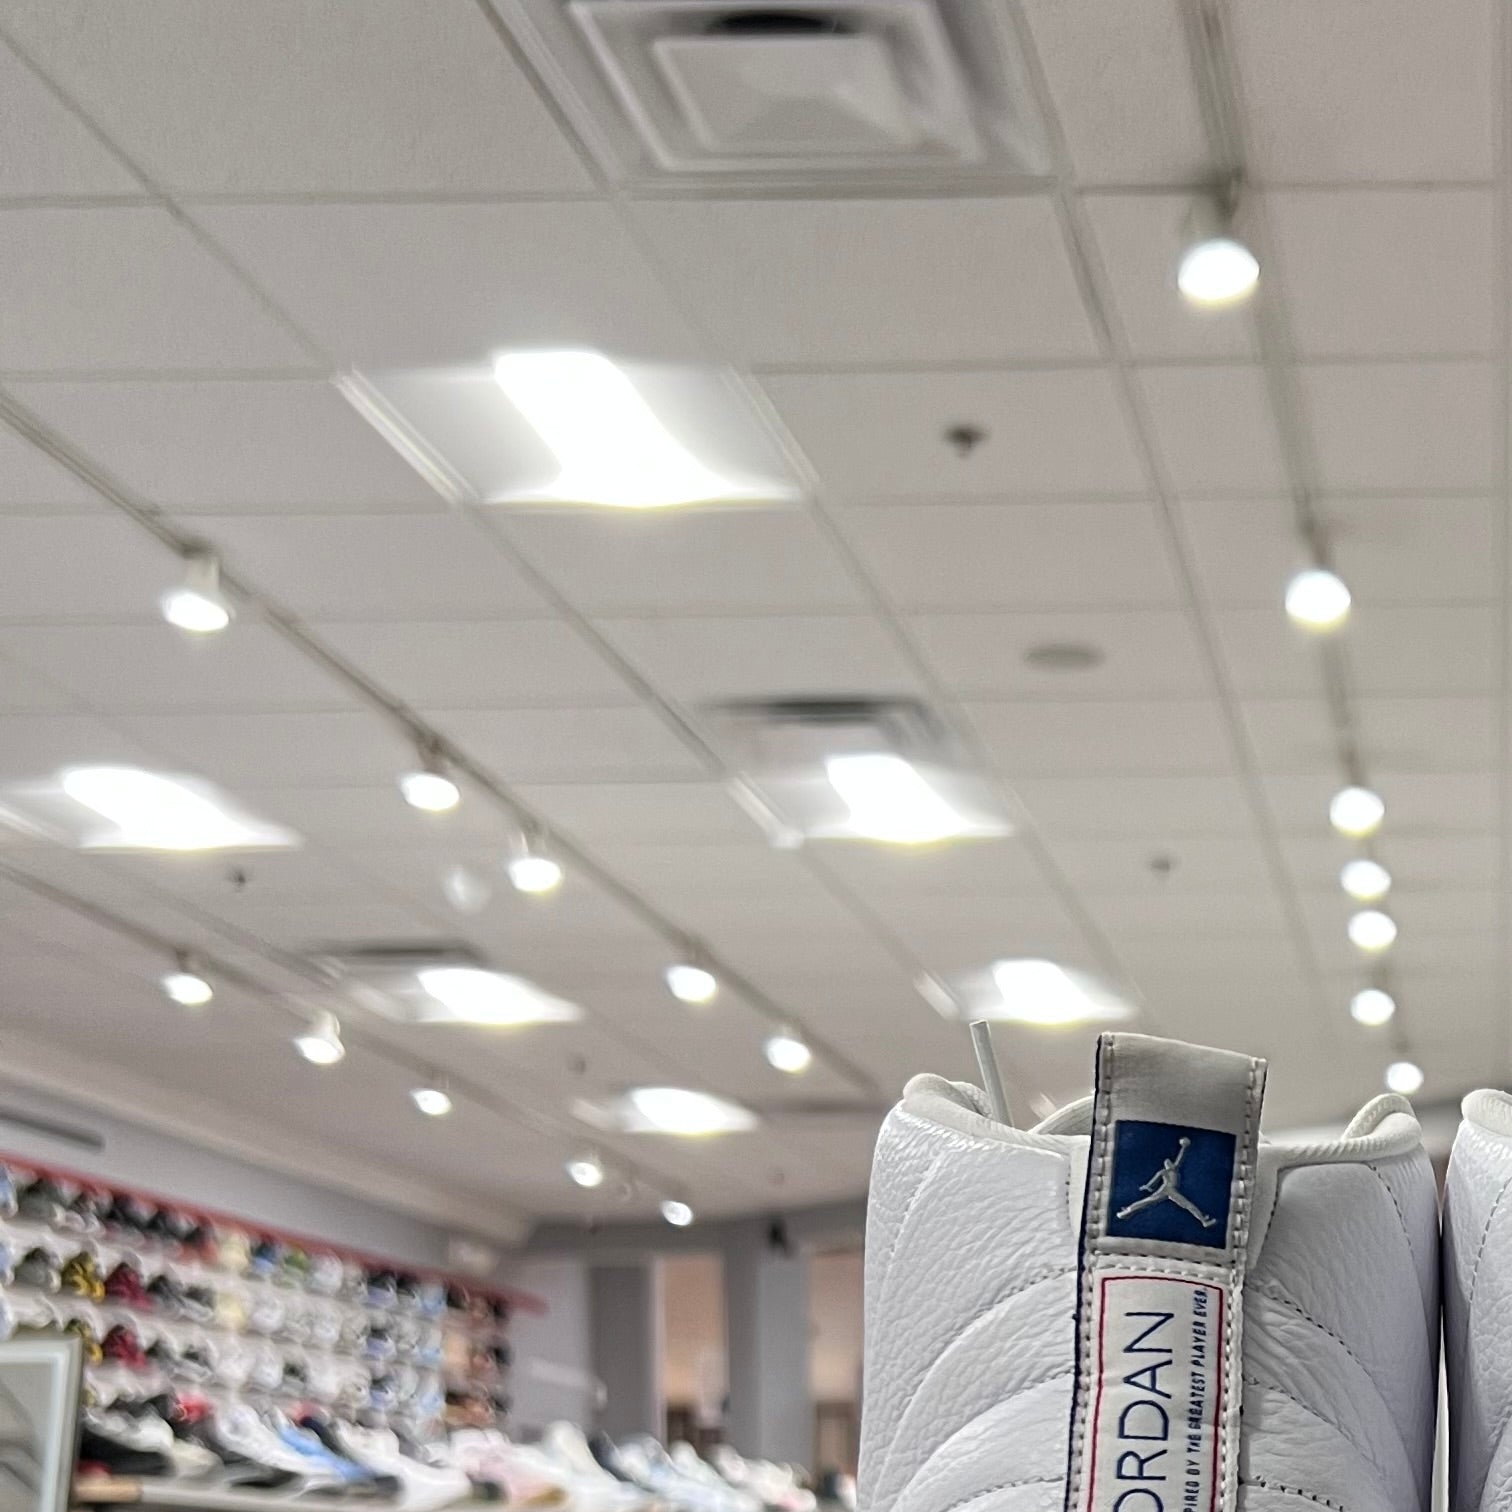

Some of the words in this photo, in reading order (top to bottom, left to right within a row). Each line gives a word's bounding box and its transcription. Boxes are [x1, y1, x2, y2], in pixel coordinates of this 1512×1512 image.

[1191, 1321, 1207, 1368] PLAYER
[1187, 1372, 1205, 1430] GREATEST
[1185, 1459, 1200, 1476] BY
